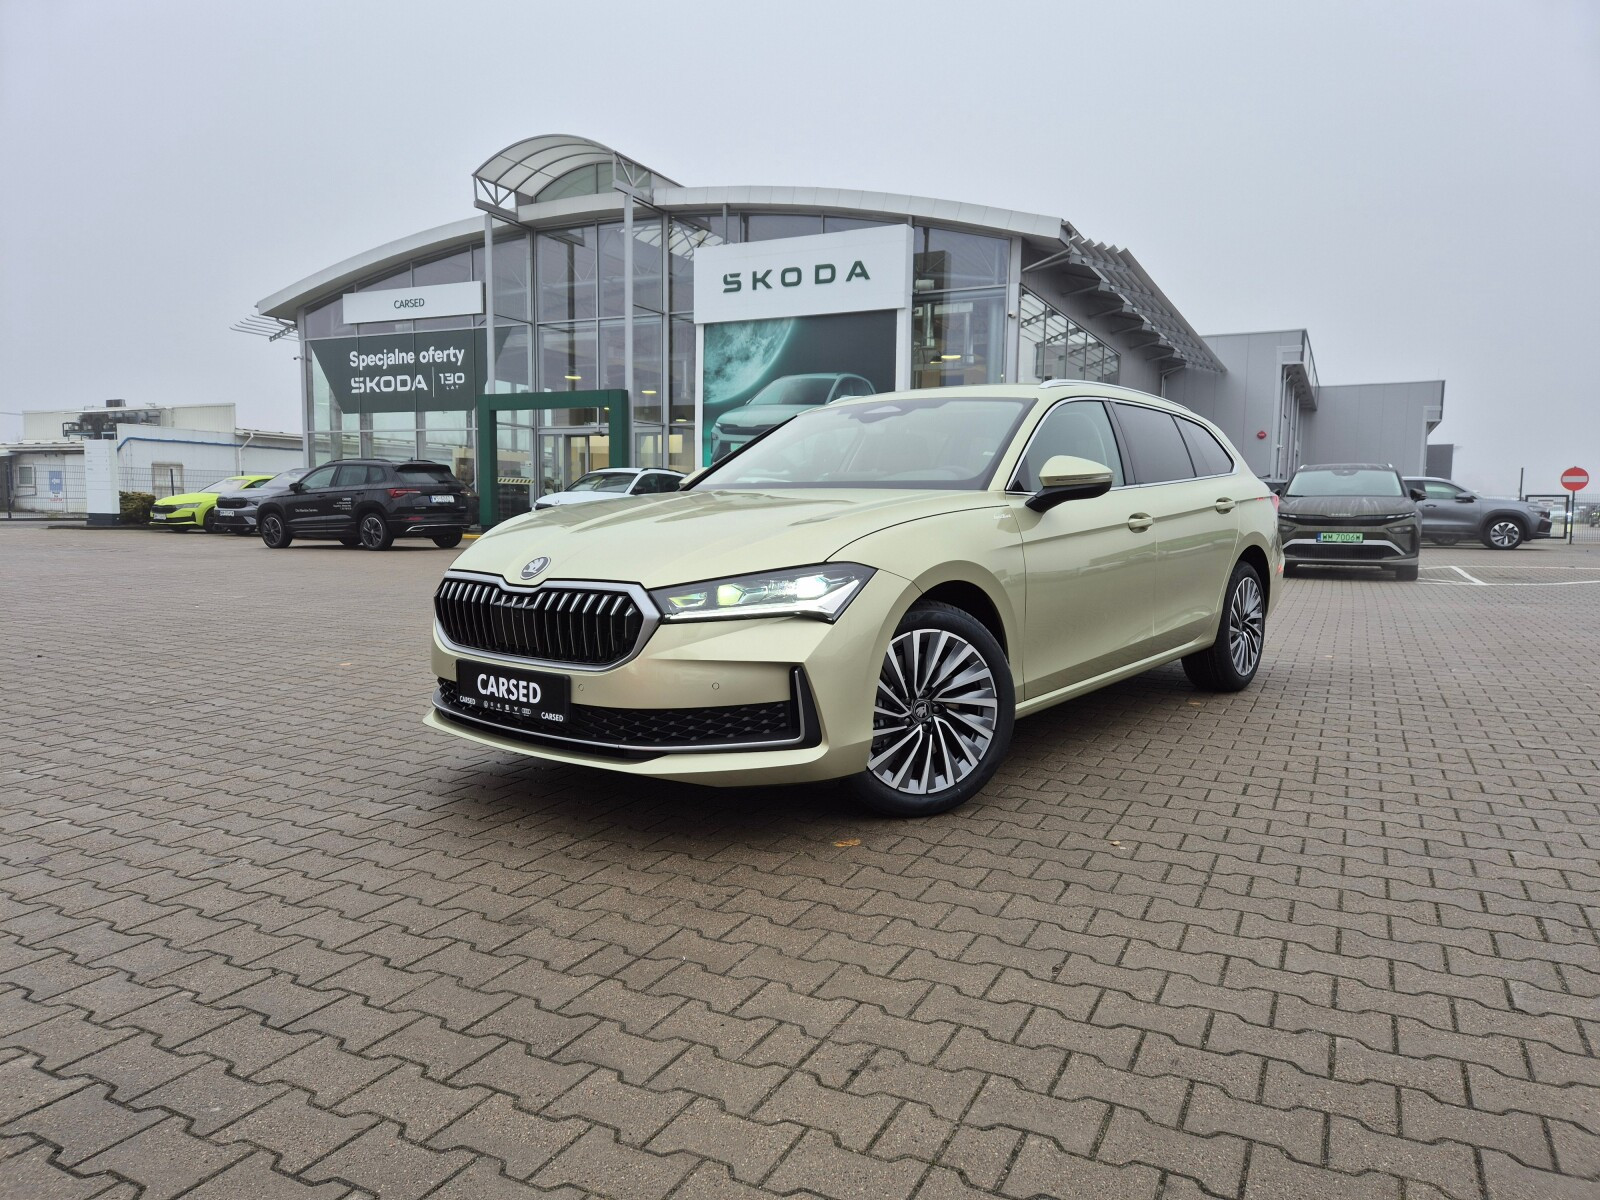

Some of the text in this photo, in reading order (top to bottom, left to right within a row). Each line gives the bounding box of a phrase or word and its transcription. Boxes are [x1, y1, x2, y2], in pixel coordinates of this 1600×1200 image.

[393, 297, 425, 309] CARSED
[349, 346, 465, 371] Specjalne oferty
[438, 372, 465, 385] 130
[477, 673, 542, 704] CARSED
[459, 695, 476, 705] CARSED
[541, 711, 564, 722] CARSED
